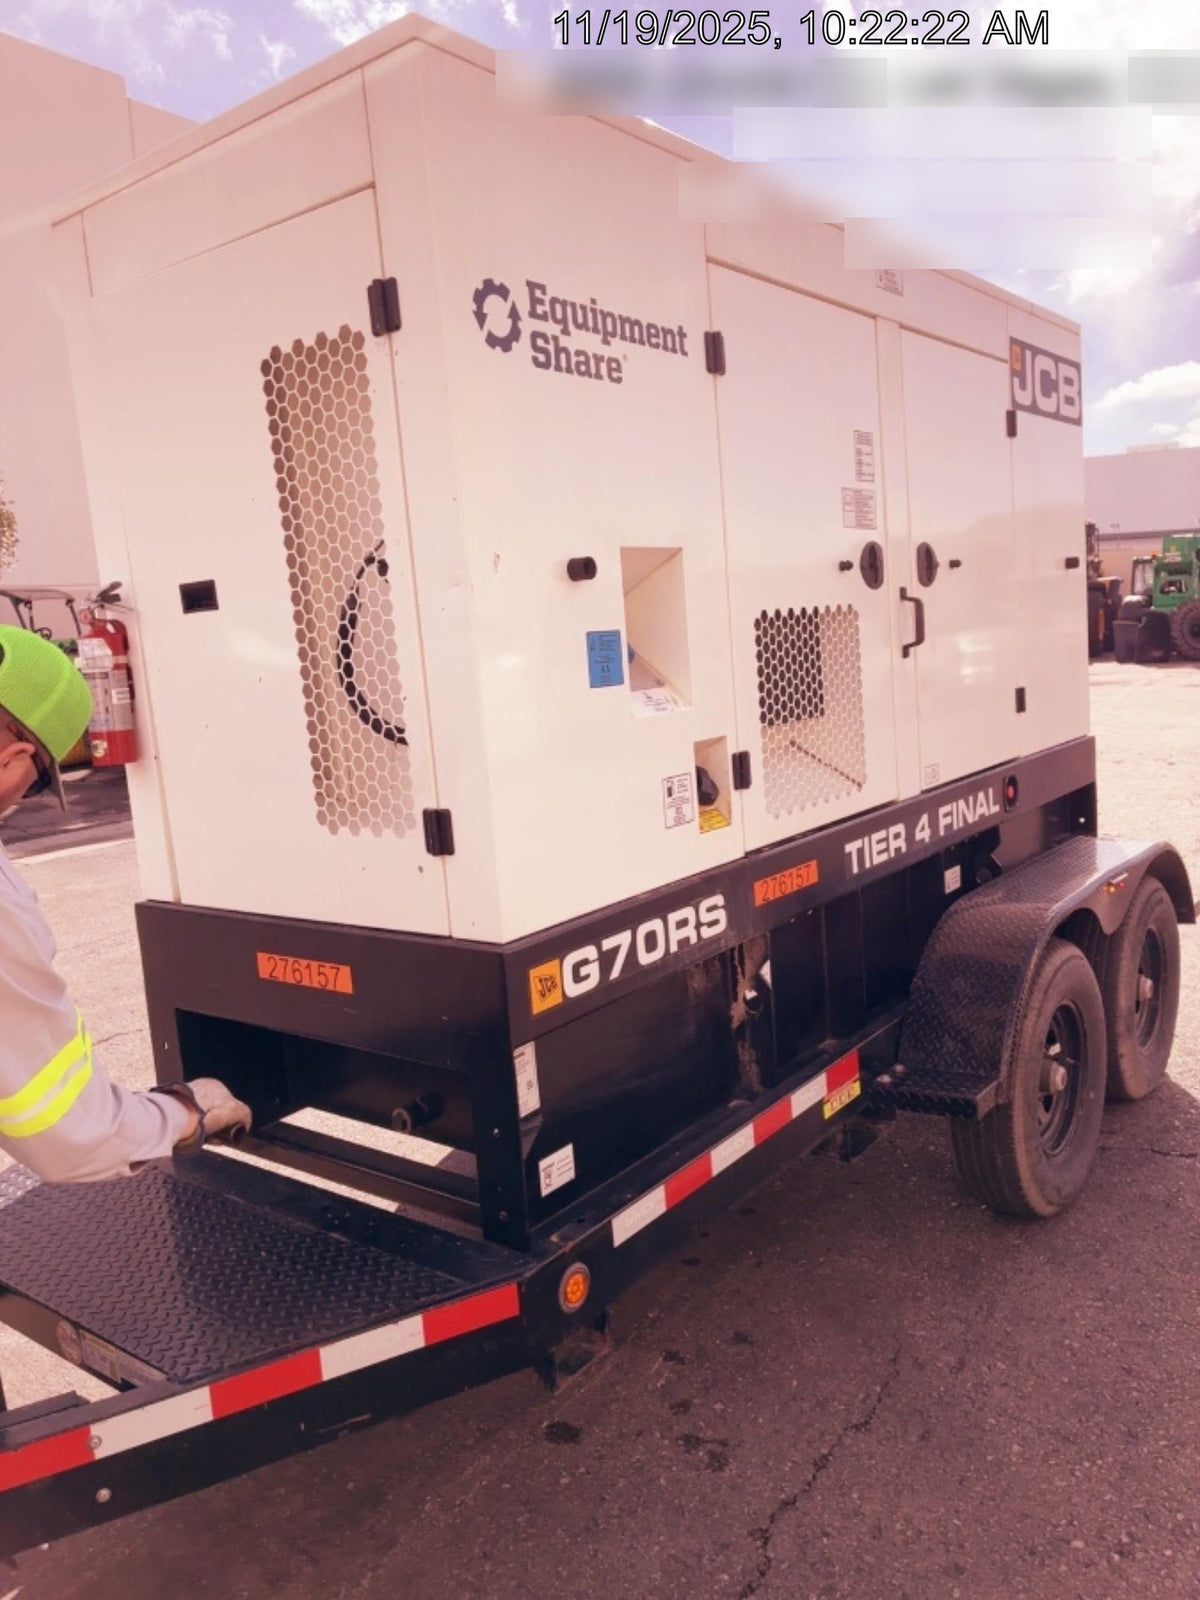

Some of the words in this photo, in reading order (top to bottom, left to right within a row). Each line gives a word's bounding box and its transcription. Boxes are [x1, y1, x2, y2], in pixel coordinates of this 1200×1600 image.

[525, 278, 689, 357] Equipment
[529, 329, 623, 385] Share
[1012, 348, 1080, 419] JCB
[844, 822, 907, 874] TIER
[915, 813, 931, 843] 4
[938, 787, 1000, 836] FINAL
[760, 863, 812, 902] 276157
[267, 955, 340, 990] 276157
[562, 893, 728, 998] G70RS
